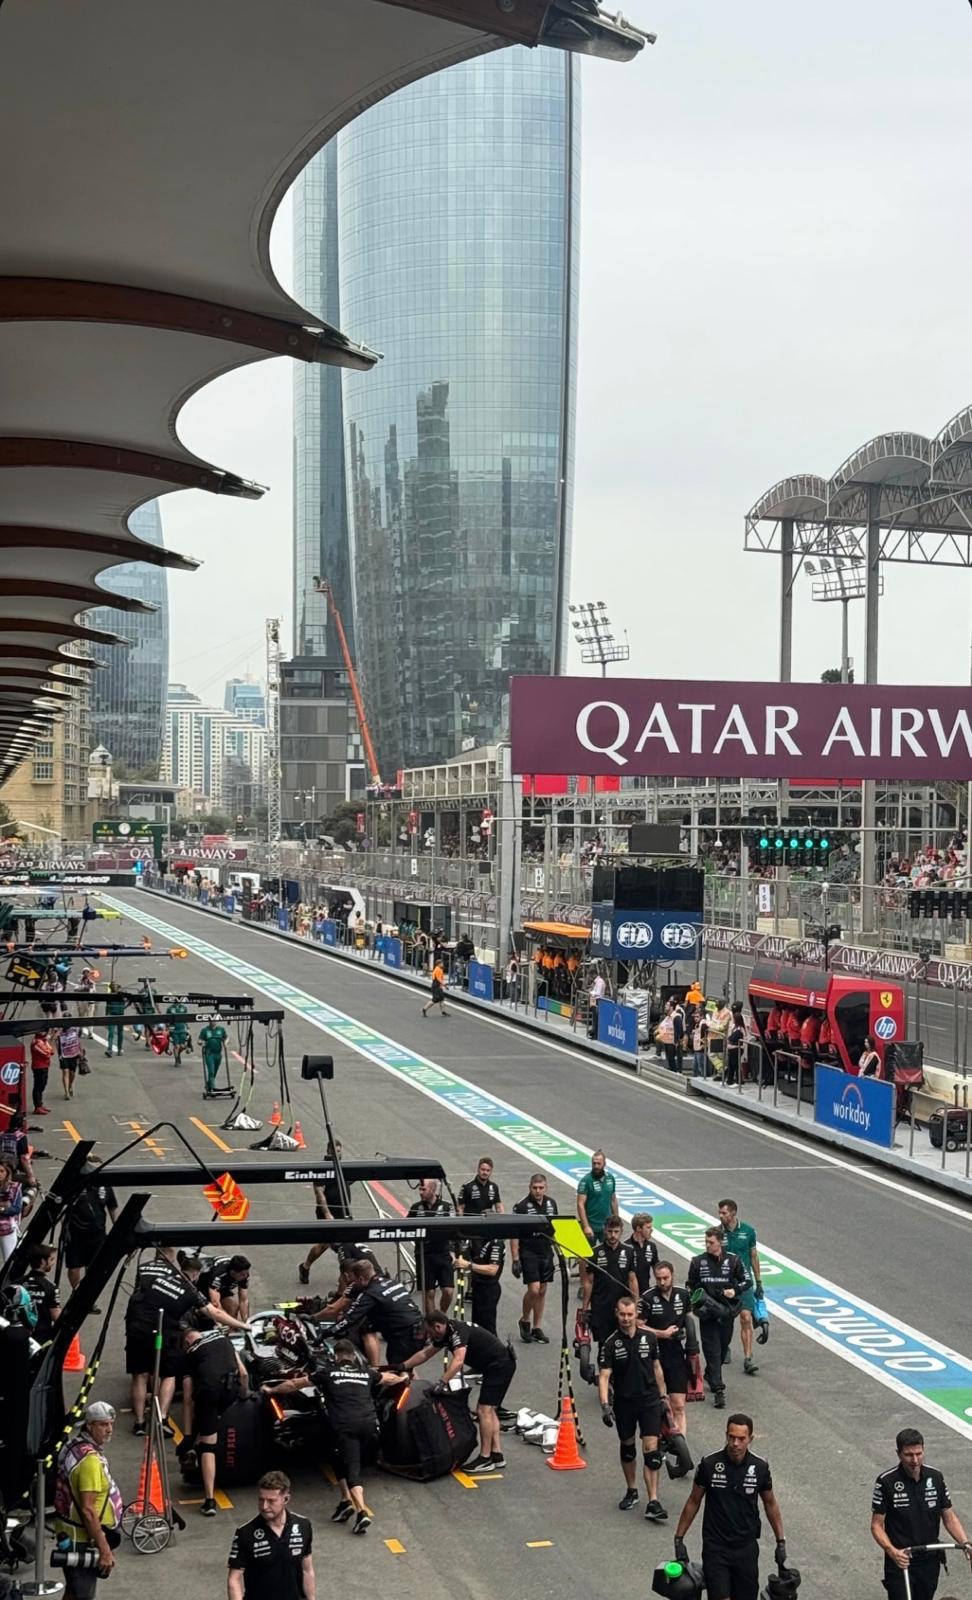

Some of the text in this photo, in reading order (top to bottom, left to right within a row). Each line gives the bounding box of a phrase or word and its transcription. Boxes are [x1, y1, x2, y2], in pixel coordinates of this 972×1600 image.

[576, 700, 803, 766] QATAR
[180, 848, 236, 860] AIRWAYS
[38, 861, 86, 870] AIRWAYS
[619, 927, 650, 944] FIA
[663, 927, 694, 945] FIA
[877, 1017, 895, 1038] hp
[3, 1063, 20, 1084] hp
[833, 1101, 870, 1131] workday
[285, 1171, 335, 1179] Einhell
[368, 1228, 427, 1239] Einhell
[784, 1295, 947, 1371] aramco
[330, 1371, 369, 1379] PETRONAS
